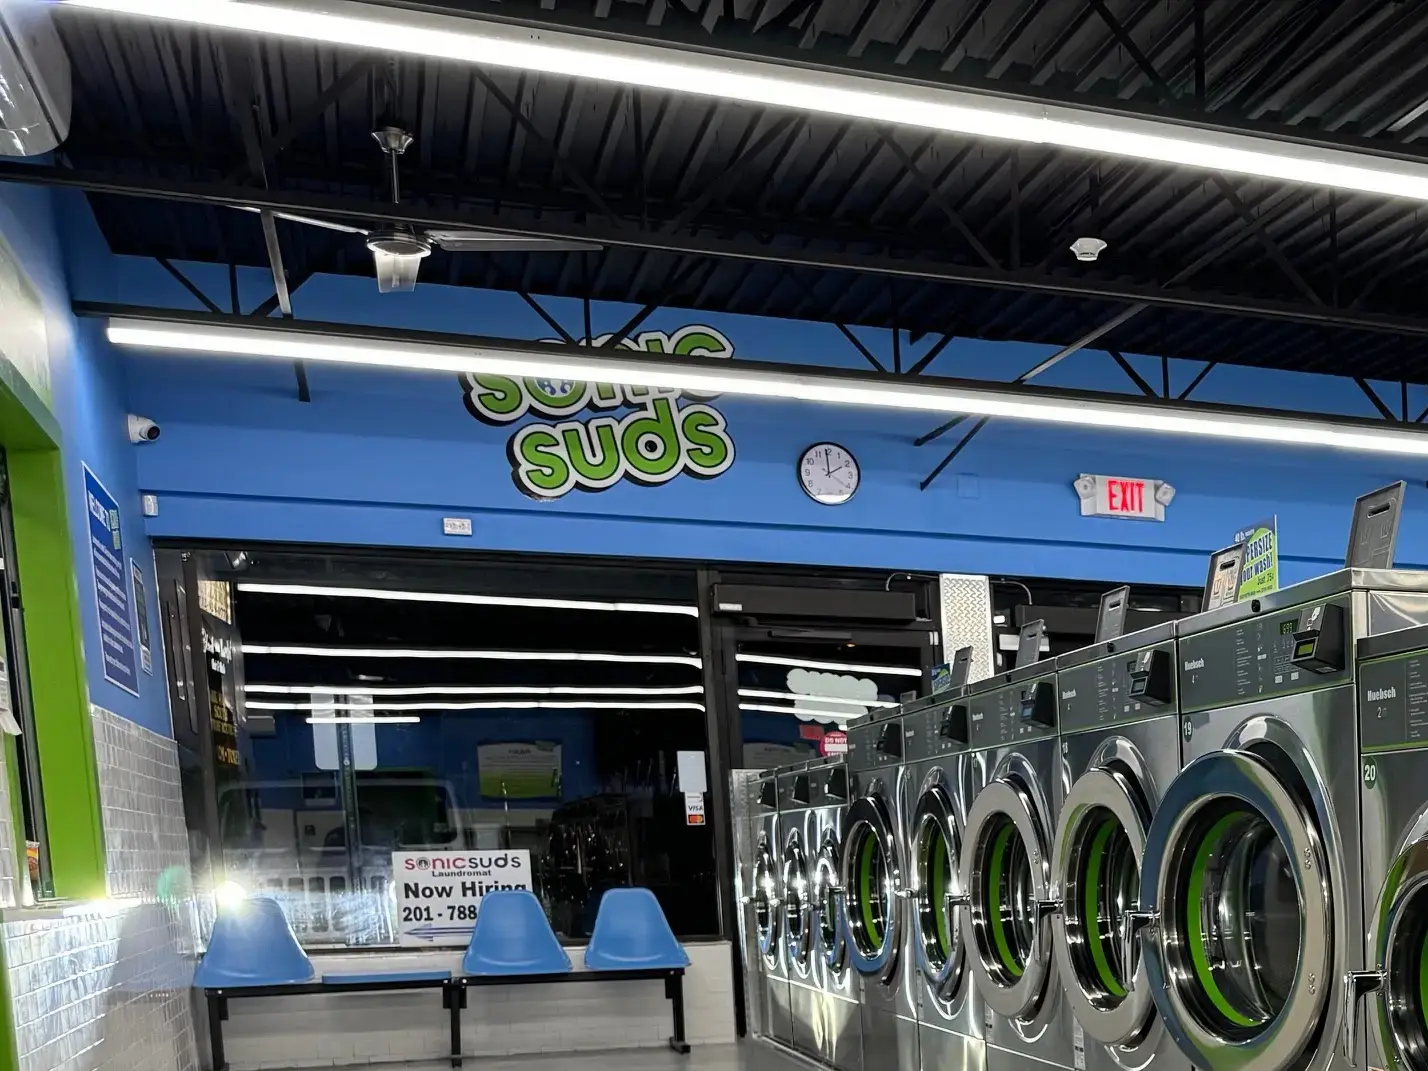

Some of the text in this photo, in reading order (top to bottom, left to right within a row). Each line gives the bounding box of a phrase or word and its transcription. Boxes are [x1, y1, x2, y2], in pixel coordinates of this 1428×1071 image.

[1107, 479, 1145, 513] EXIT
[1246, 531, 1273, 564] PERSIZE
[1367, 686, 1396, 702] Huebsch
[1377, 706, 1382, 718] 2
[1184, 721, 1192, 736] 19
[1364, 764, 1376, 781] 20
[432, 869, 492, 877] Laundromat
[404, 882, 453, 899] Now
[403, 906, 434, 922] 201
[447, 905, 477, 920] 788
